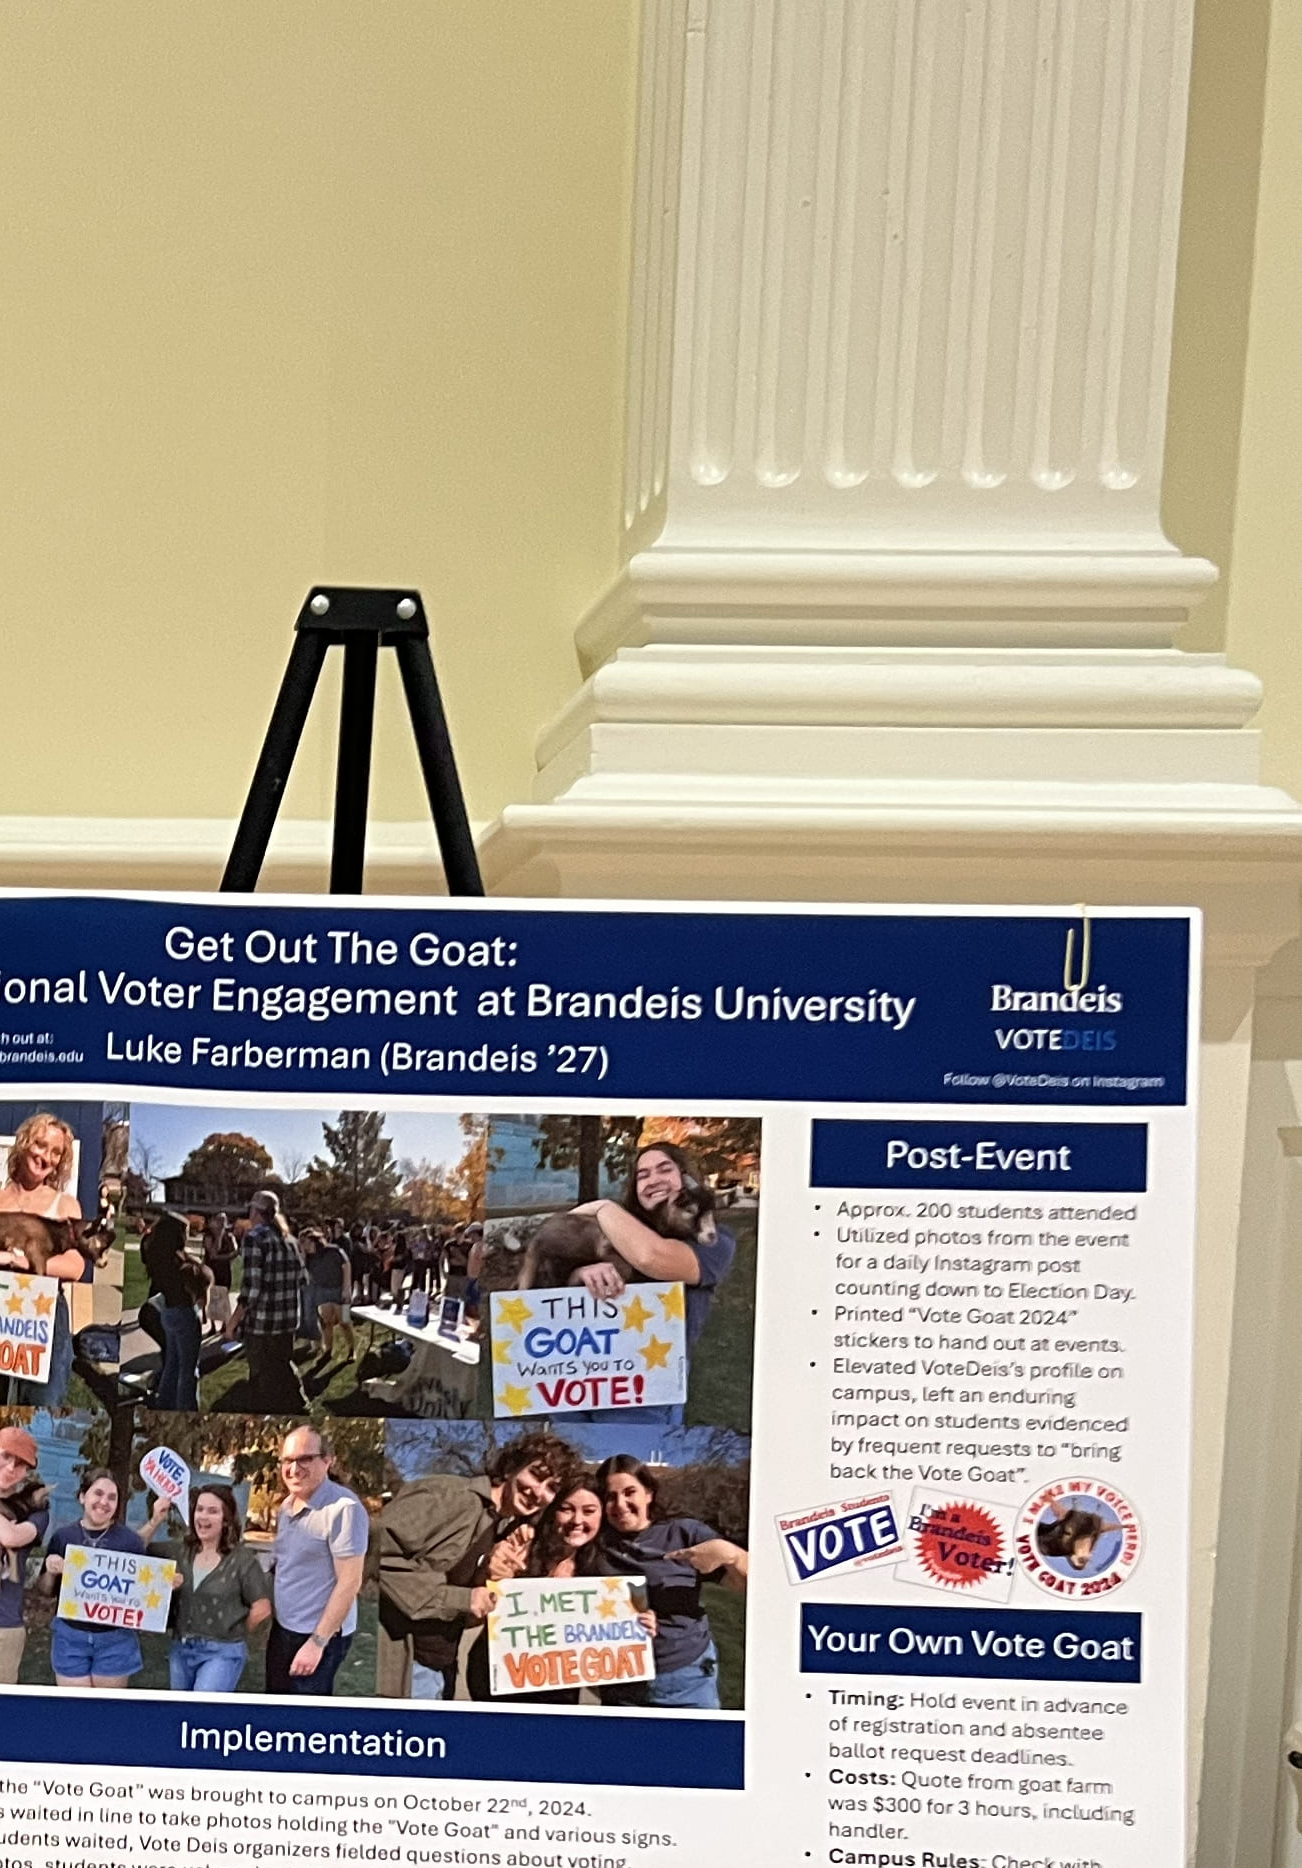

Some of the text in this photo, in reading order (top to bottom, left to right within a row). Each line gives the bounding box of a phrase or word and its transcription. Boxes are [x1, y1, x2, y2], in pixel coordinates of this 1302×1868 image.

[165, 926, 517, 967] Get Out The Goat:
[97, 970, 202, 1009] Voter
[213, 978, 458, 1022] Engagement
[477, 986, 516, 1016] at
[527, 983, 702, 1020] Brandeis
[715, 986, 916, 1031] University
[990, 984, 1123, 1013] Brandeis
[12, 1032, 34, 1045] out
[36, 1032, 54, 1044] at:
[106, 1031, 182, 1064] Luke
[192, 1037, 370, 1069] Farberman
[380, 1041, 537, 1077] (Brandeis
[994, 1028, 1117, 1051] VOTEDEIS
[943, 1072, 1165, 1091] Follow @VoteDeis on Instagram
[887, 1140, 1072, 1171] Post-Event
[836, 1201, 1137, 1221] Approx. 200 students attended
[837, 1227, 1129, 1248] Utilized photos from the event
[541, 1296, 619, 1319] THIS
[834, 1305, 903, 1323] Printed
[966, 1307, 1015, 1325] Goat
[524, 1326, 621, 1358] GOAT
[536, 1374, 645, 1407] VOTE!
[159, 1450, 185, 1486] VOTE,
[780, 1494, 890, 1531] Brandeis Students
[1068, 1481, 1093, 1493] MY
[1096, 1485, 1133, 1521] VOICE
[789, 1510, 896, 1571] VOTE
[907, 1515, 991, 1546] Brandeis
[94, 1554, 137, 1575] THIS
[938, 1541, 1015, 1577] Voter!
[1016, 1534, 1041, 1572] VOTE
[1038, 1570, 1077, 1595] GOAT
[80, 1569, 136, 1595] GOAT
[83, 1602, 144, 1628] VOTE!
[506, 1590, 597, 1617] I MET
[501, 1624, 557, 1648] THE
[808, 1624, 1134, 1661] Your Own Vote Goat
[827, 1689, 1128, 1715] Timing: Hold event in advance
[181, 1721, 446, 1758] Implementation
[0, 1778, 28, 1794] the
[148, 1788, 185, 1801] was
[191, 1786, 263, 1807] brought
[269, 1790, 287, 1805] to
[292, 1793, 369, 1810] campus
[374, 1797, 397, 1809] on
[403, 1794, 481, 1812] October
[539, 1800, 592, 1817] 2024.
[828, 1768, 1111, 1796] Costs: Quote from goat farm
